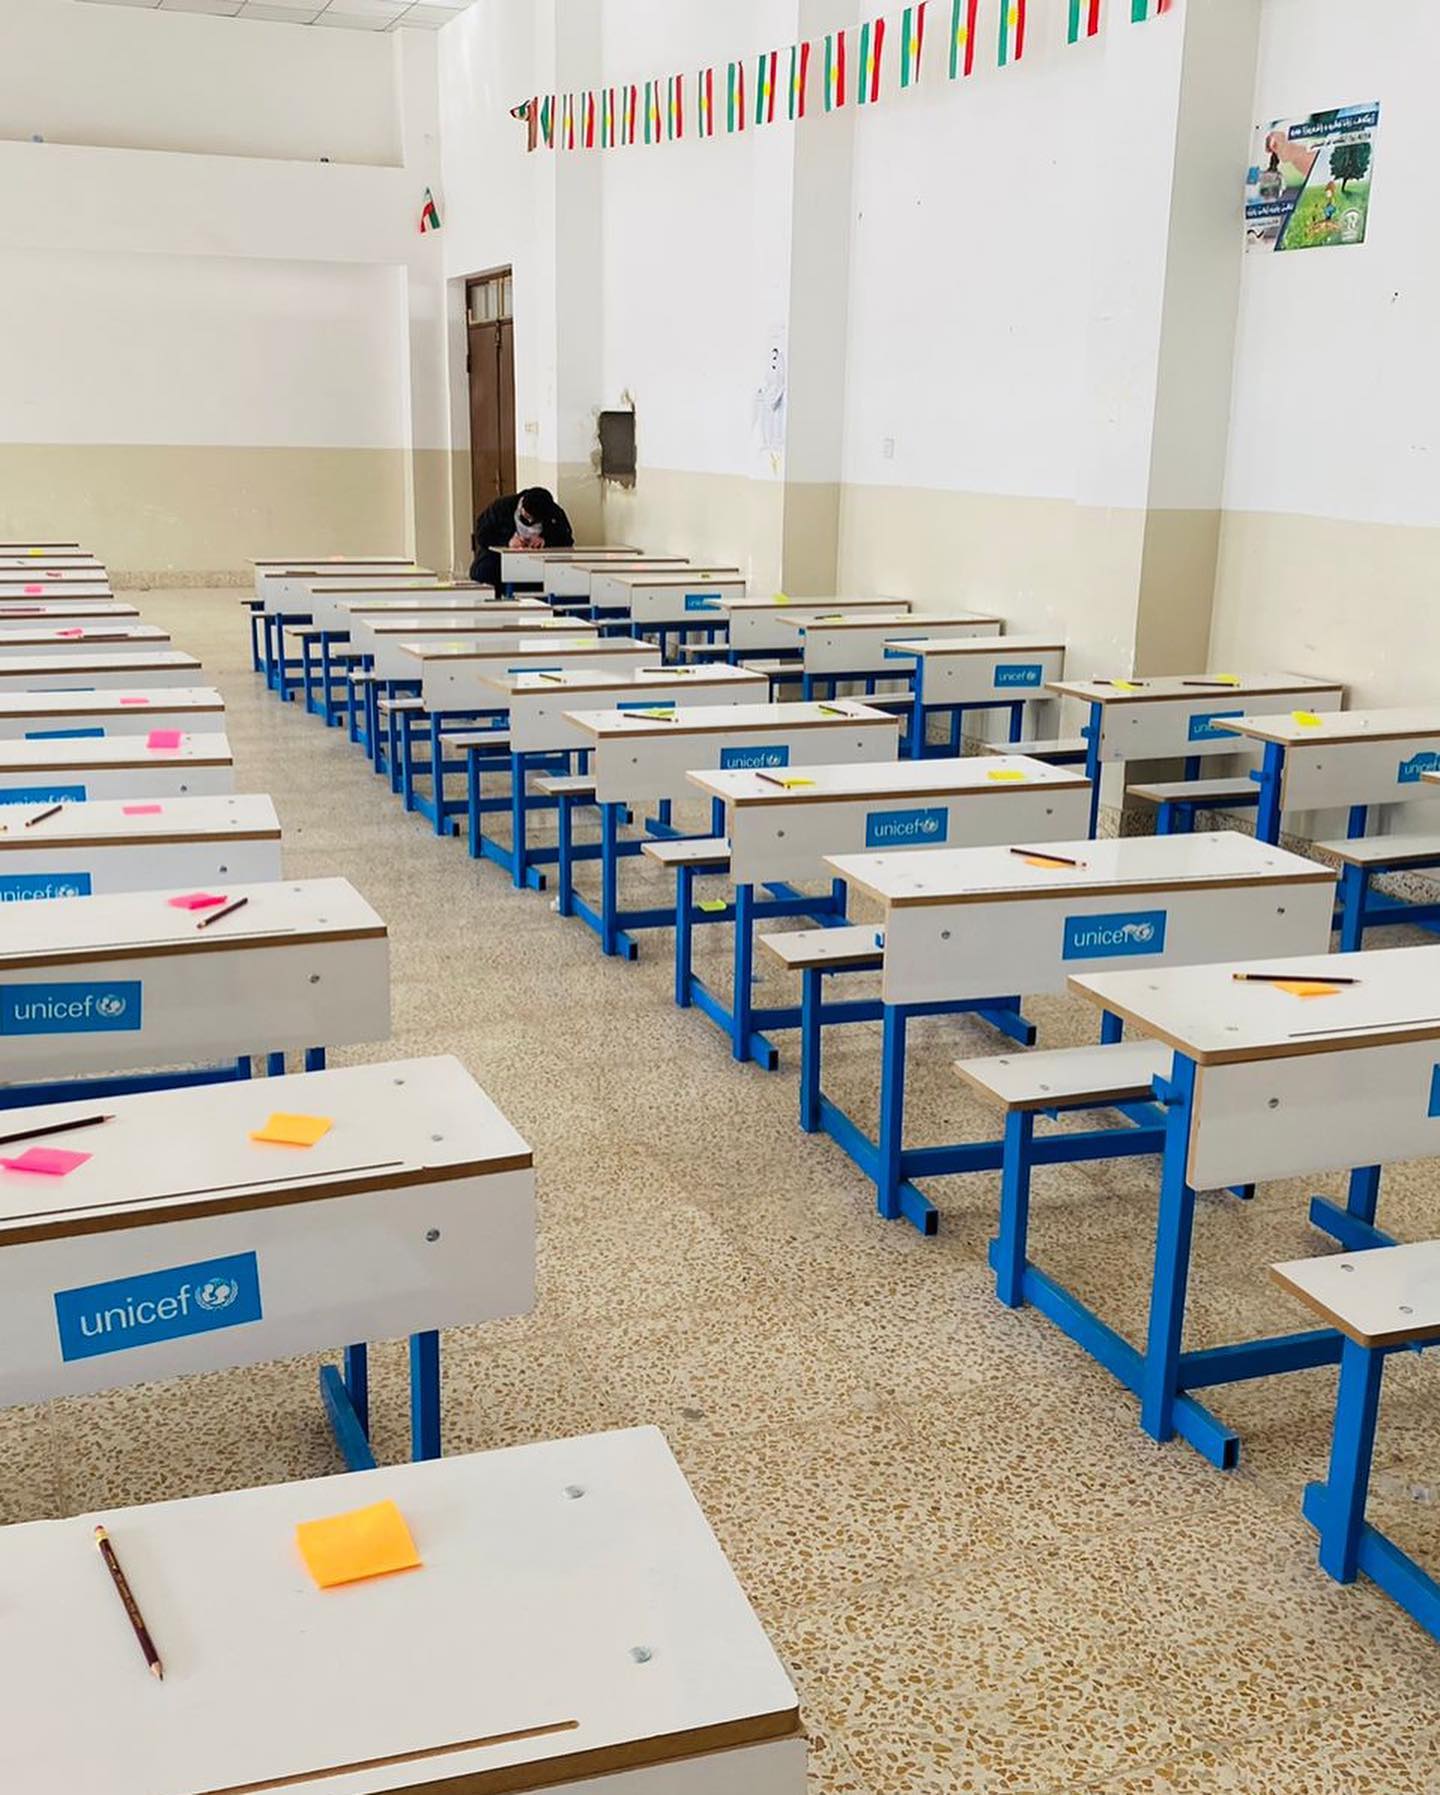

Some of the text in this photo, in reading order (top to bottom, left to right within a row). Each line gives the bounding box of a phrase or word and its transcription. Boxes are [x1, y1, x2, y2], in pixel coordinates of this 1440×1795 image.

[726, 753, 765, 768] unicef
[874, 818, 919, 837] unicef
[0, 883, 52, 902] nicef
[1073, 925, 1129, 948] unicef
[14, 994, 93, 1020] unicef
[80, 1284, 190, 1337] unicef
